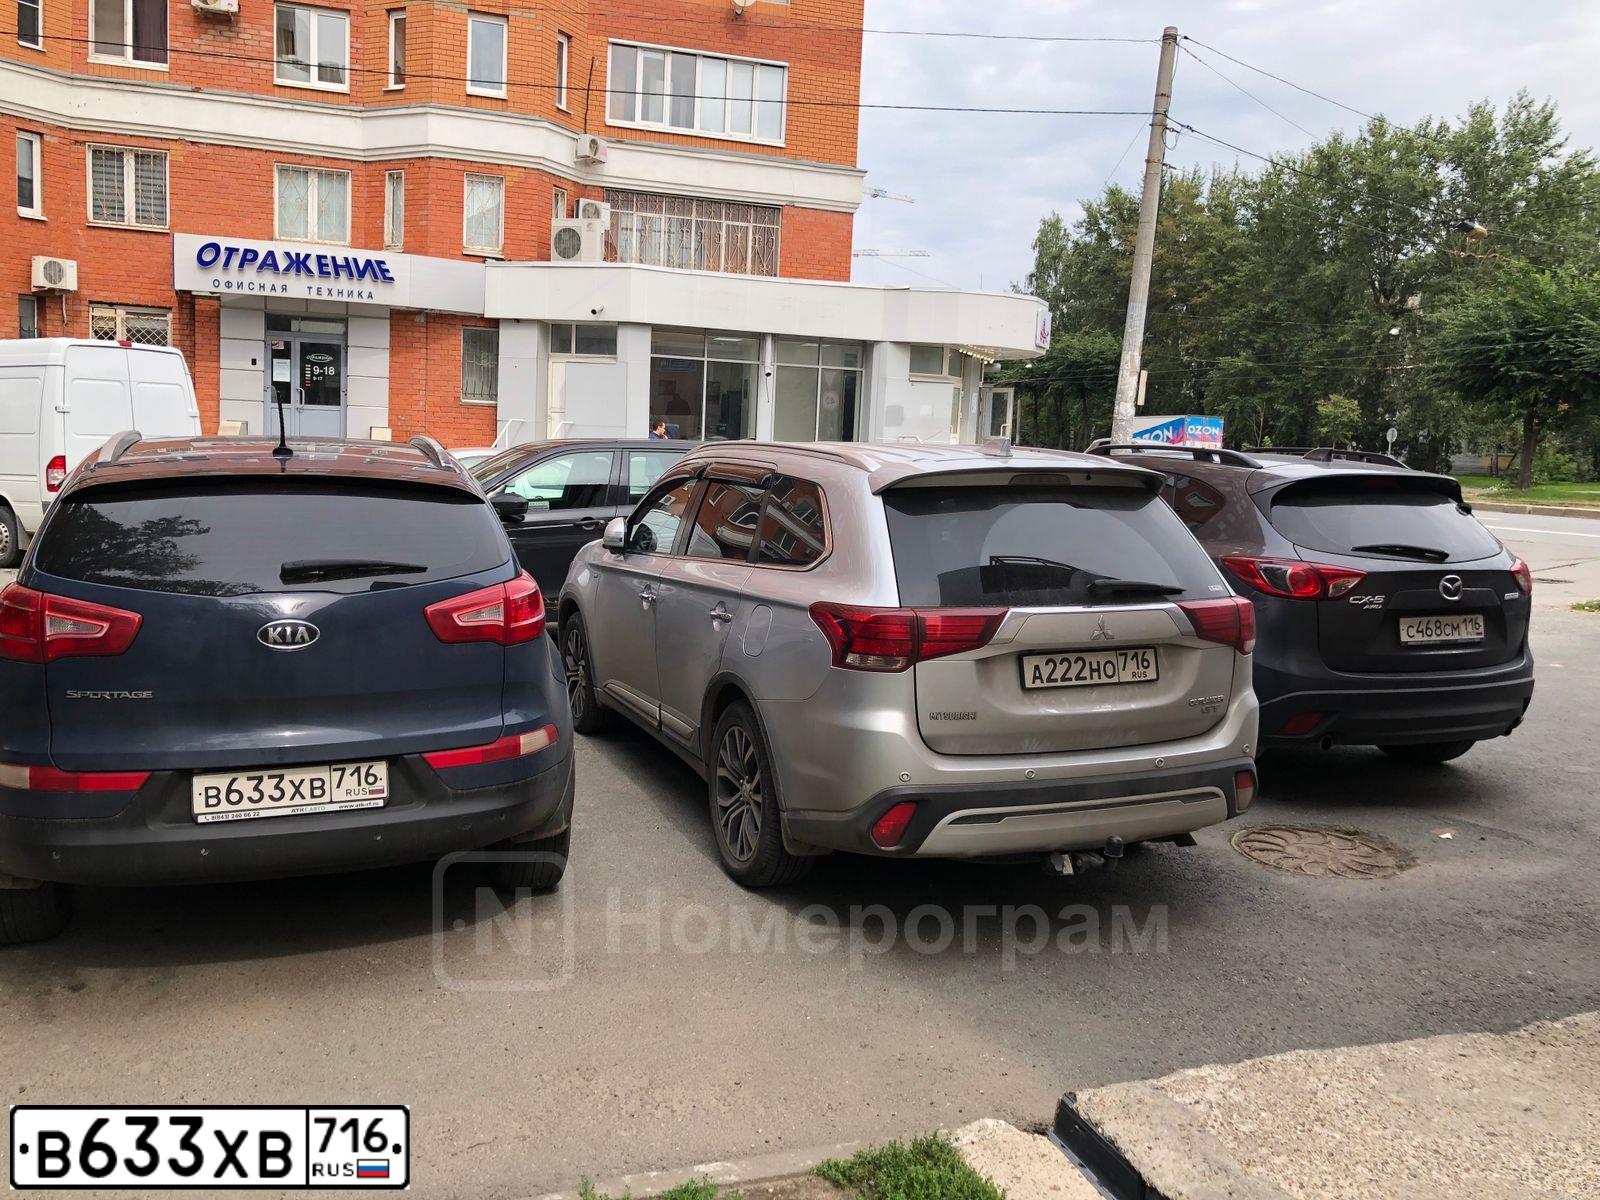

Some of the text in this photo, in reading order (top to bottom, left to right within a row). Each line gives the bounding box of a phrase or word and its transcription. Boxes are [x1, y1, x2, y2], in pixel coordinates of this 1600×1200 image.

[196, 242, 396, 283] ОТРАЖЕНИЕ
[212, 278, 374, 300] ОФИСНАЯ ТЕХНИКА
[313, 365, 335, 375] 9-18
[1187, 425, 1219, 435] OZON
[1349, 595, 1385, 604] CX-5
[1406, 617, 1480, 638] С468СМ 116
[267, 626, 310, 643] KIA
[1031, 651, 1151, 684] А222НО 716
[1131, 671, 1148, 679] RUS
[66, 690, 153, 700] SPORTAGE
[204, 764, 378, 808] В633ХВ 716
[345, 787, 368, 797] RUS
